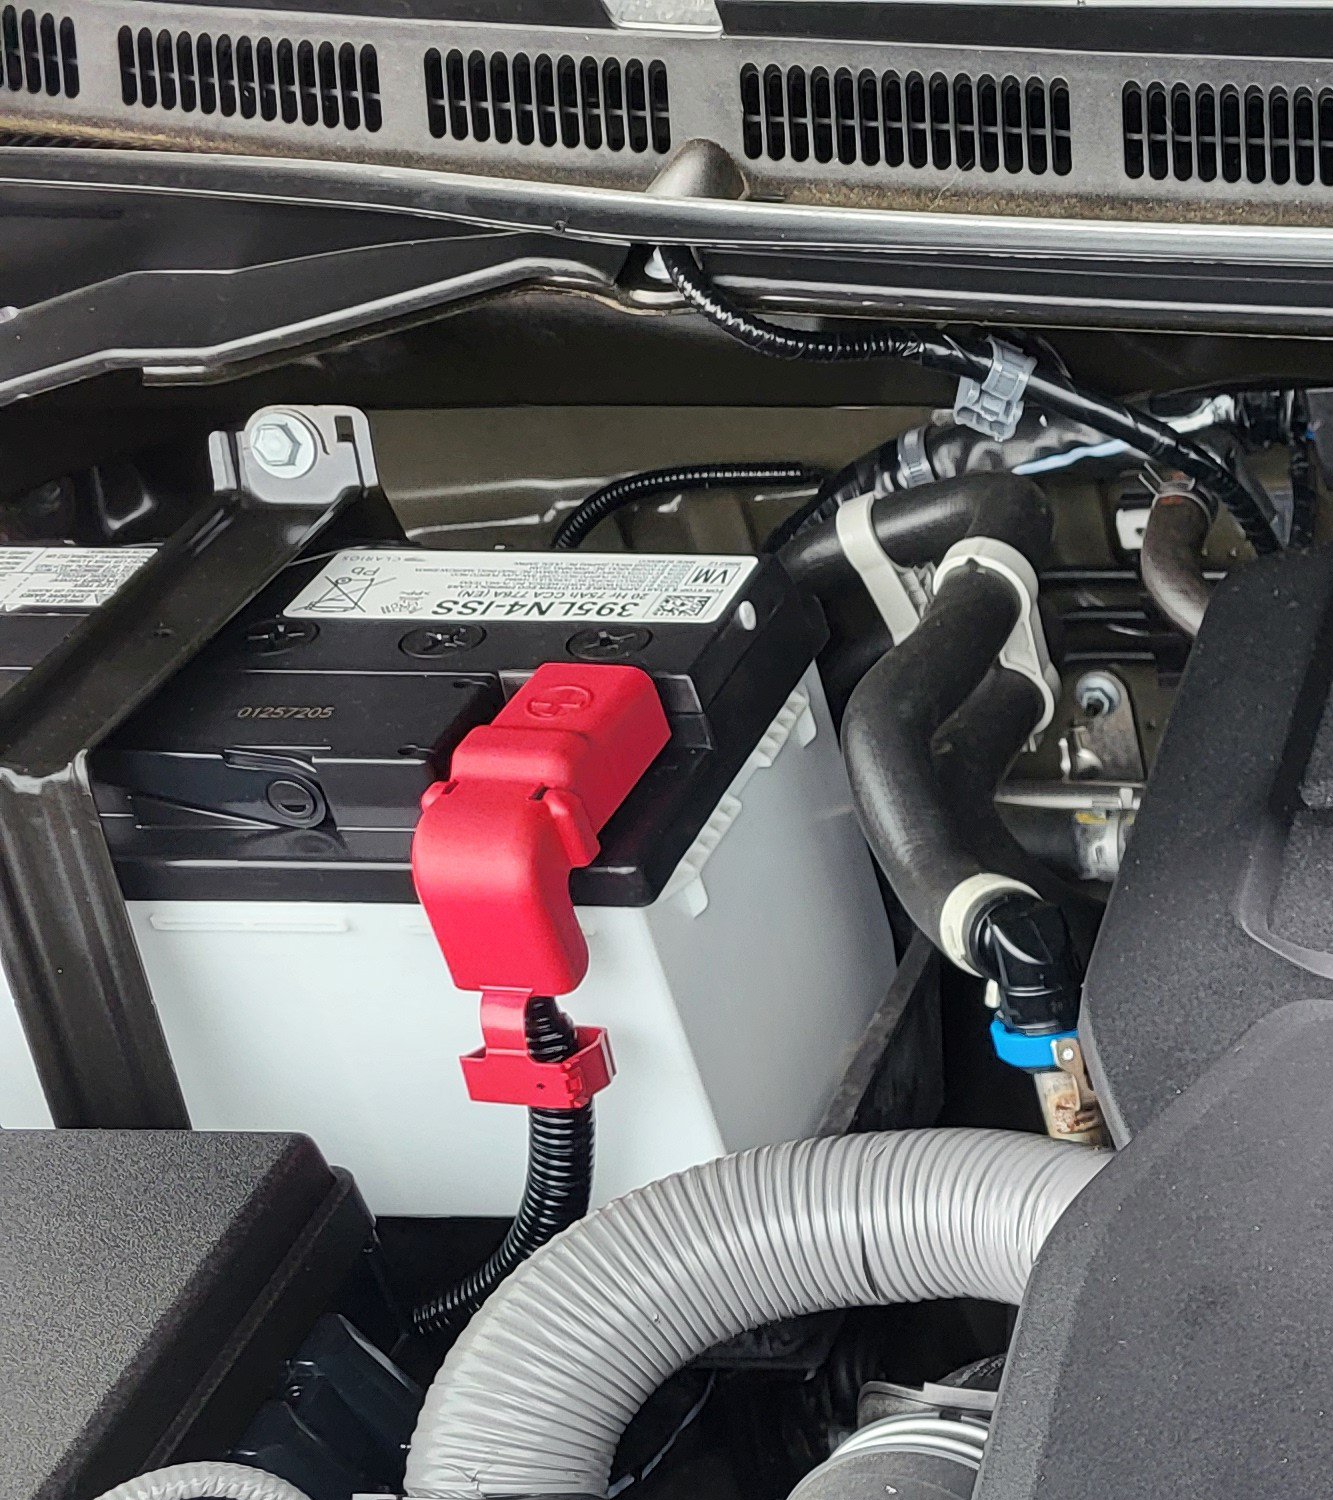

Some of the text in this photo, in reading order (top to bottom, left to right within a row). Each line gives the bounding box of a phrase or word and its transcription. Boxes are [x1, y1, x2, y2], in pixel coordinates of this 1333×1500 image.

[694, 568, 730, 584] VM
[431, 600, 639, 618] 395LN4-ISS
[237, 706, 335, 719] 01257205
